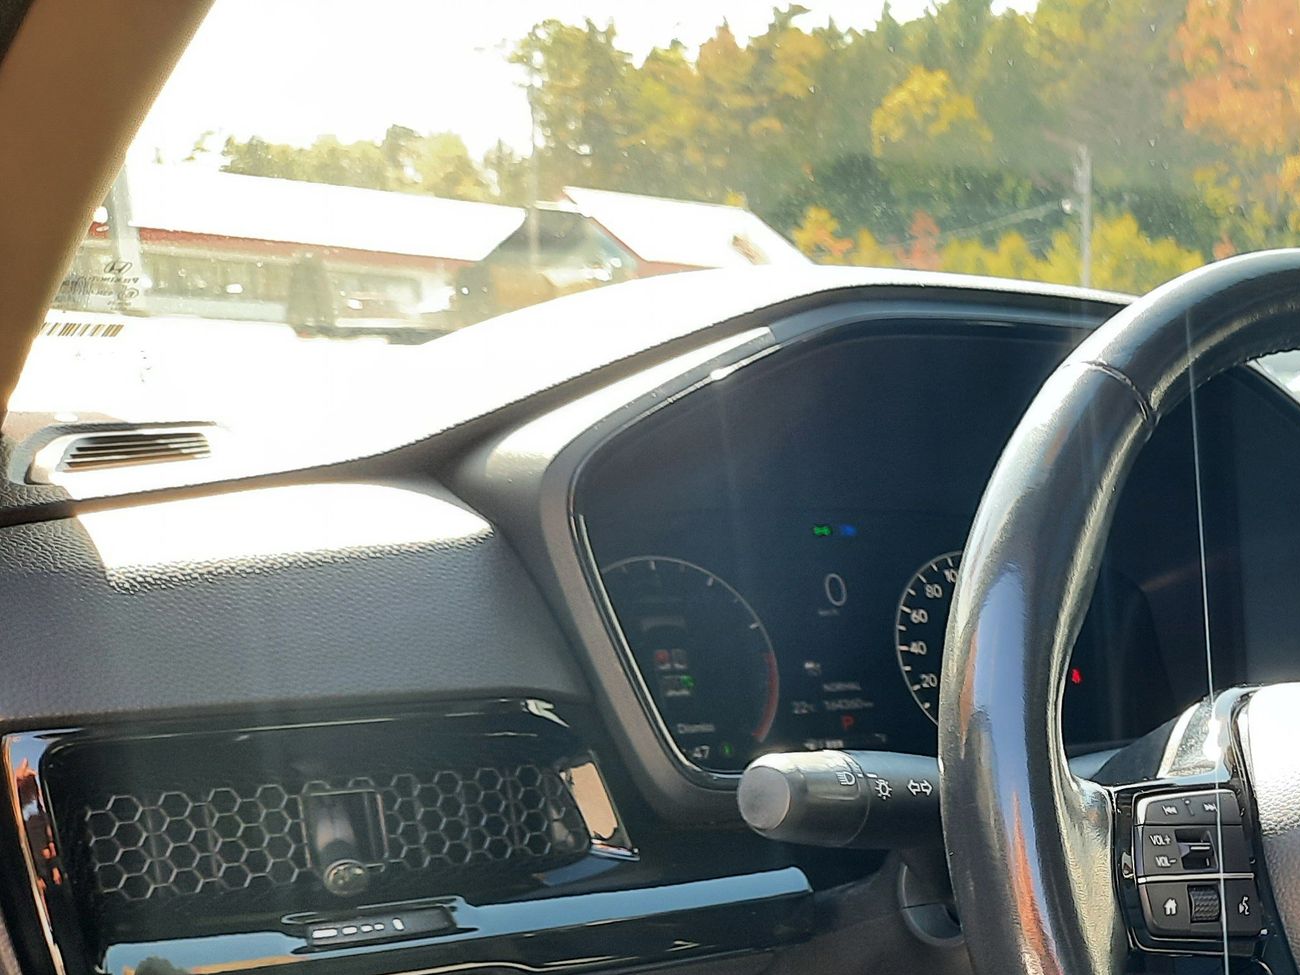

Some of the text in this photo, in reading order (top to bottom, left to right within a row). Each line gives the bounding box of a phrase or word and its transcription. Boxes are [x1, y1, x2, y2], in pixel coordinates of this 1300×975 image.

[943, 568, 959, 583] 10
[825, 573, 847, 606] 0
[925, 583, 943, 599] 80
[910, 608, 928, 624] 60
[909, 640, 927, 656] 40
[920, 672, 938, 688] 20
